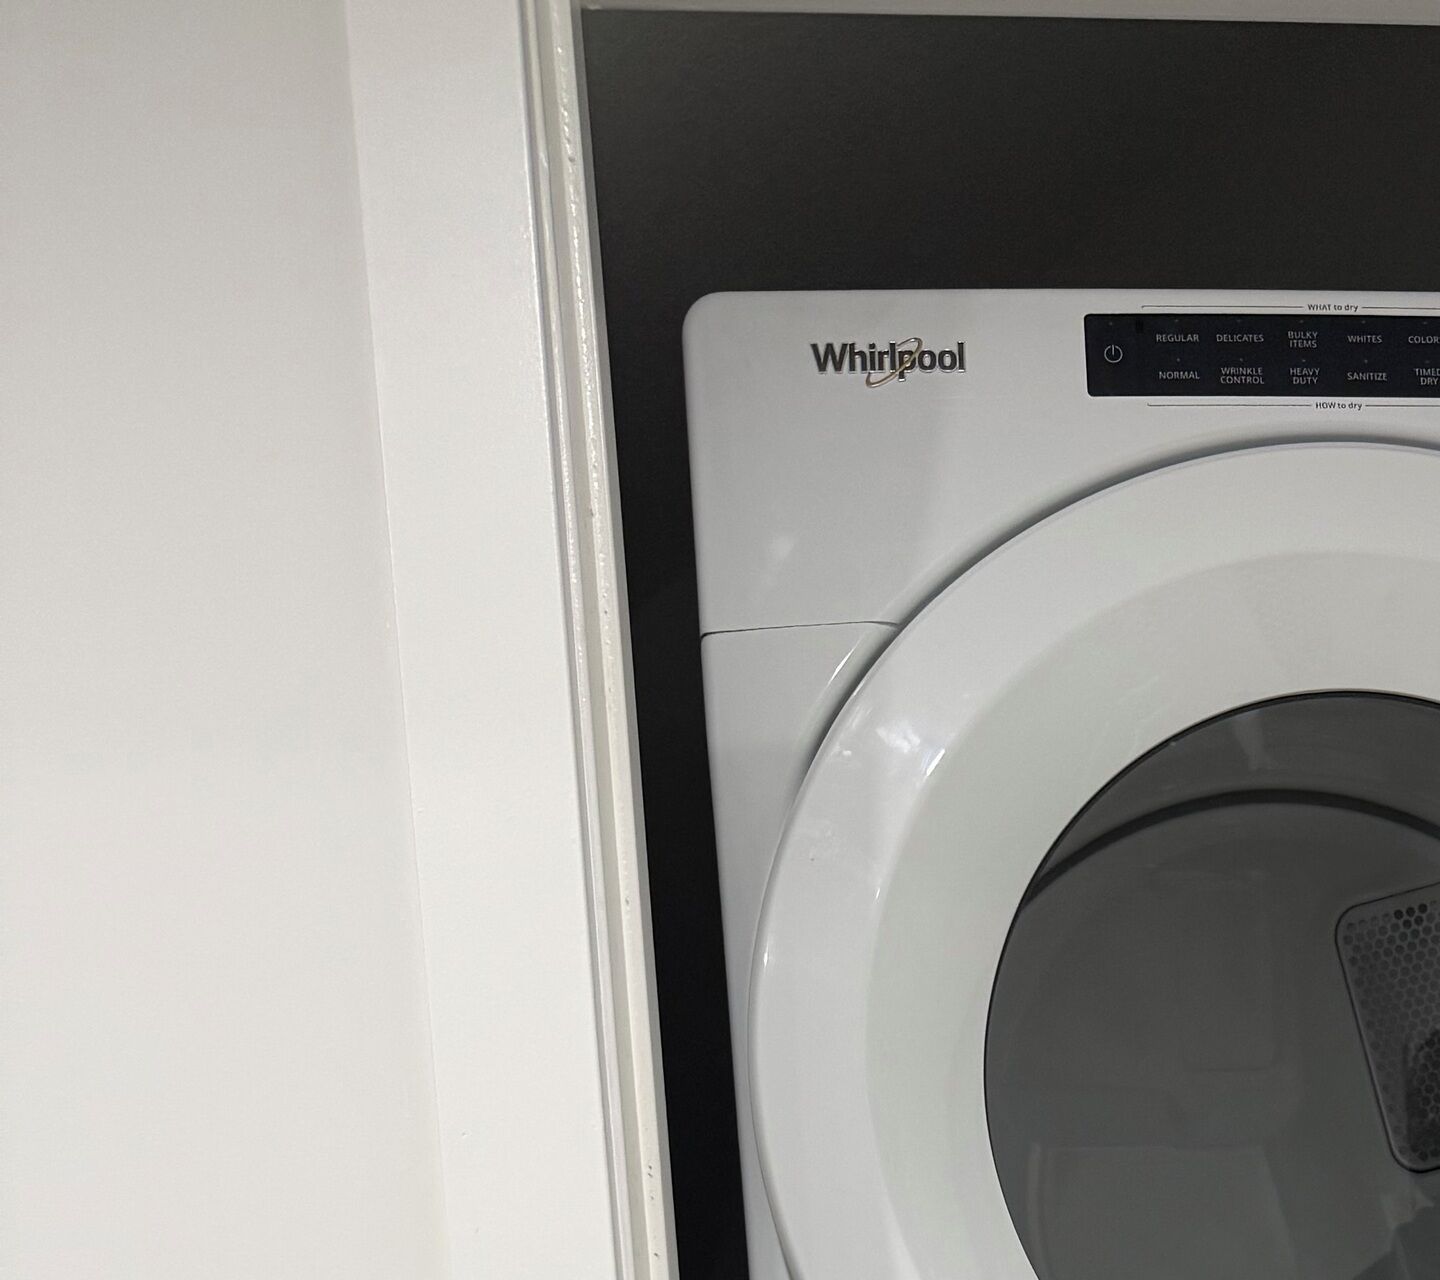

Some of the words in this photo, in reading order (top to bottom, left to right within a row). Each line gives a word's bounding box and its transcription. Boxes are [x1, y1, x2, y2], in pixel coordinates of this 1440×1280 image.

[1307, 303, 1332, 311] WHAT
[1344, 303, 1359, 313] dry
[1155, 333, 1200, 343] REGULAR
[1216, 333, 1265, 343] DELICATES
[1287, 330, 1318, 340] BULKY
[1347, 335, 1383, 344] WHITES
[1289, 339, 1318, 349] ITEMS
[809, 338, 967, 386] Whirlpool
[1158, 370, 1201, 381] NORMAL
[1220, 367, 1263, 376] WRINKLE
[1289, 367, 1320, 376] HEAVY
[1220, 375, 1265, 385] CONTROL
[1292, 376, 1319, 385] DUTY
[1347, 372, 1388, 382] SANITIZE
[1420, 376, 1438, 386] DRY
[1315, 401, 1336, 409] HOW
[1348, 401, 1363, 411] dry
